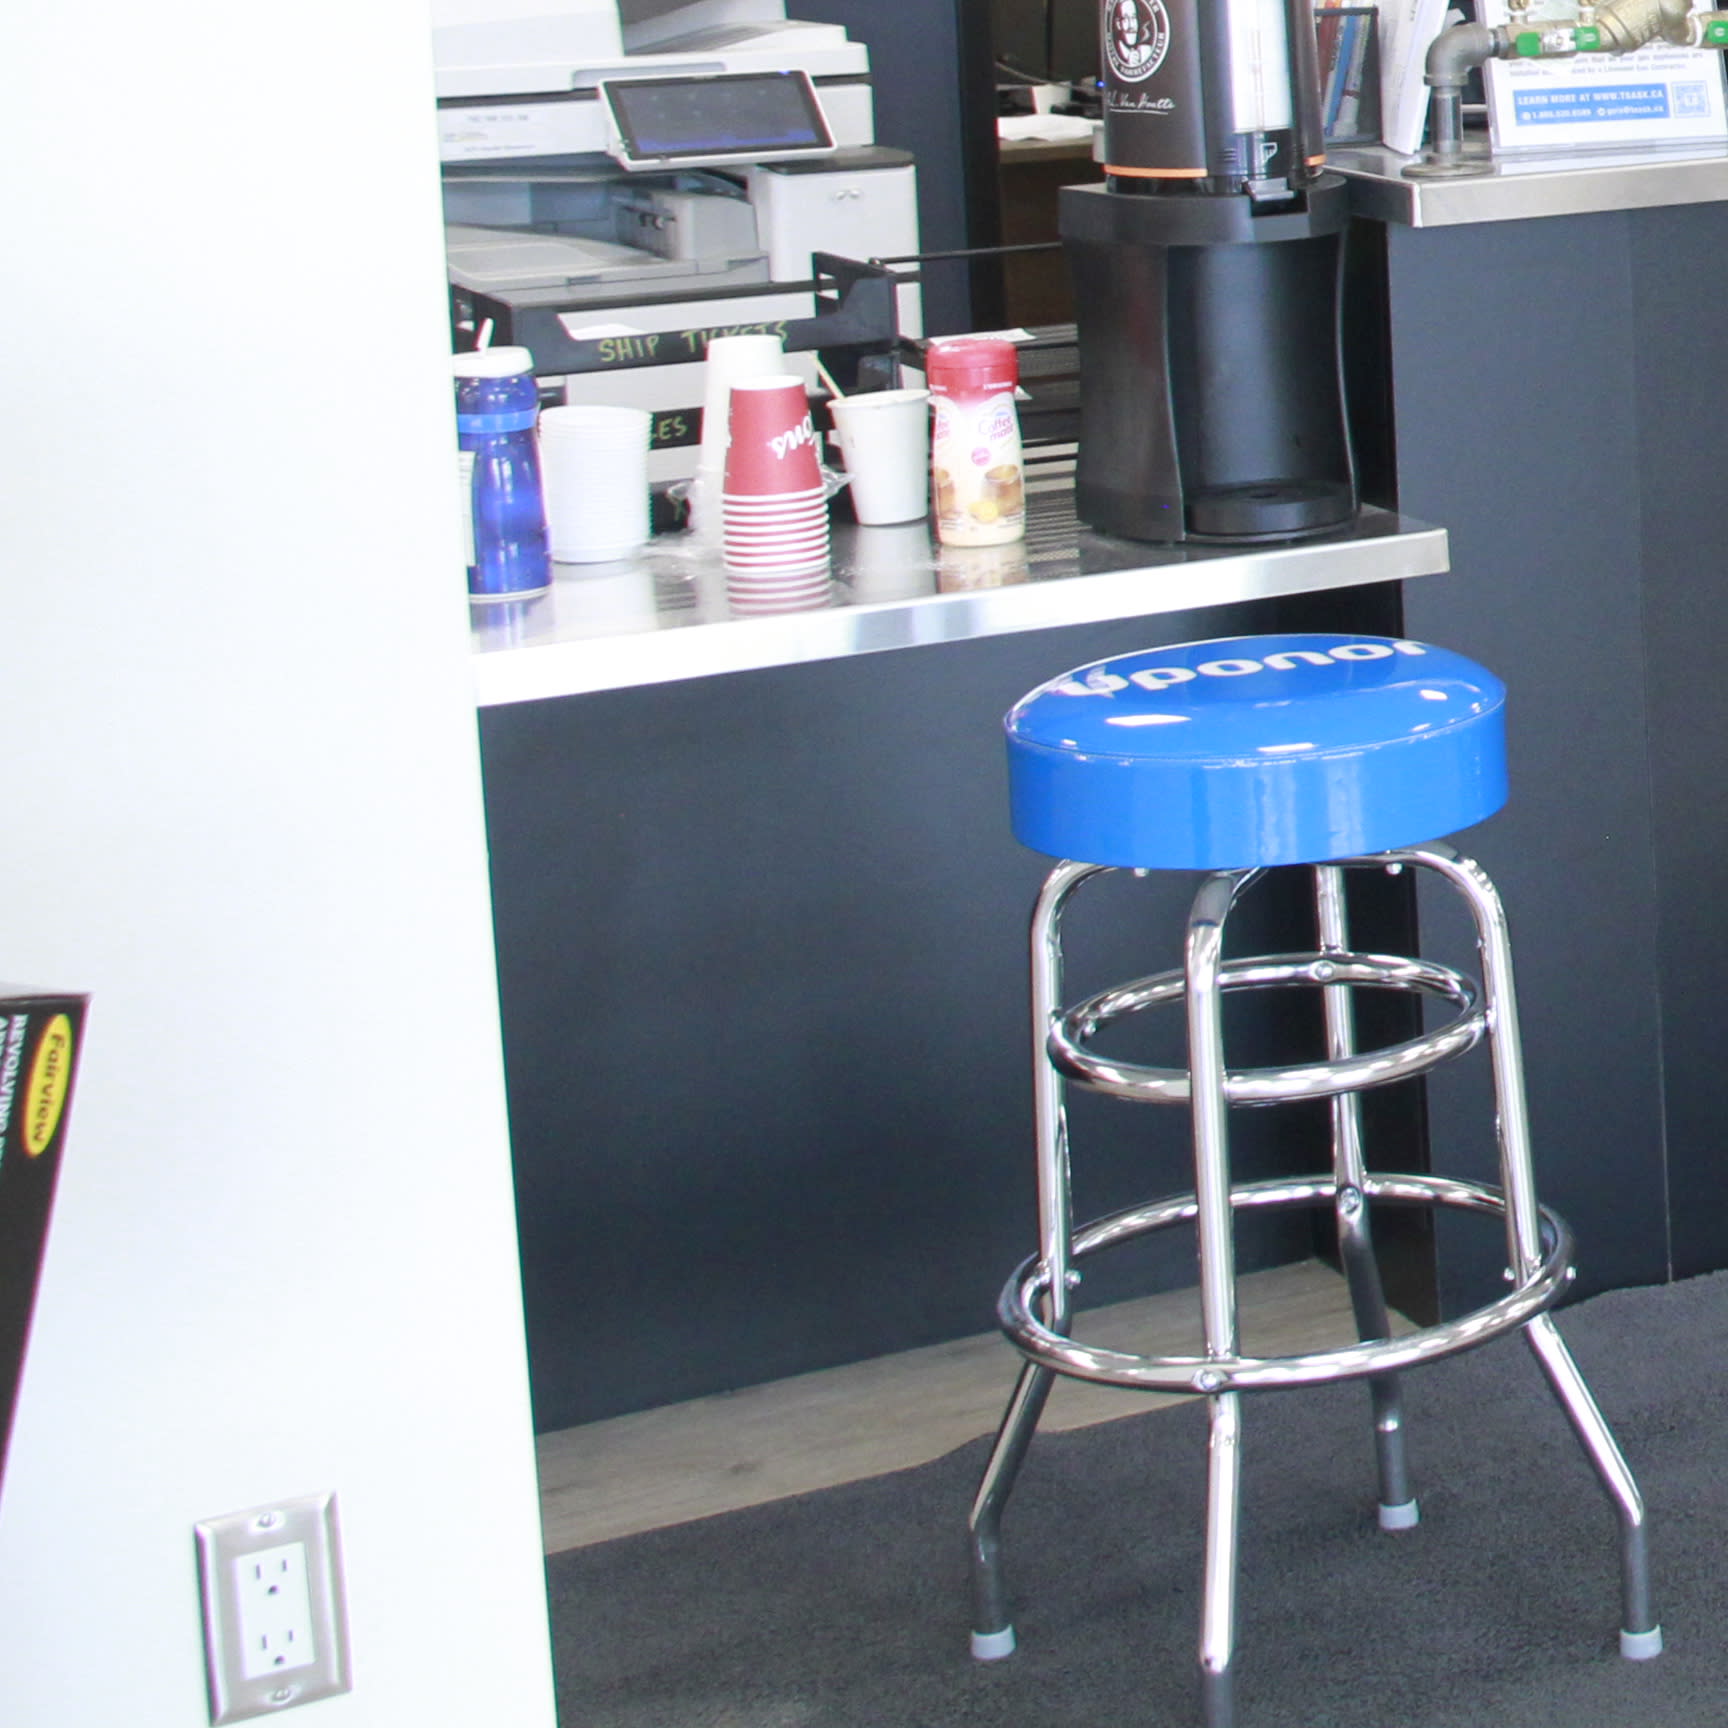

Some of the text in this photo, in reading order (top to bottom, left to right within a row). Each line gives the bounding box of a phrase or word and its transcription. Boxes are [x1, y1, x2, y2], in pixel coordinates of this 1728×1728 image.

[1518, 94, 1549, 106] LEARN
[1579, 92, 1591, 103] AT
[598, 334, 660, 362] SHIP
[34, 1034, 65, 1143] Fairview
